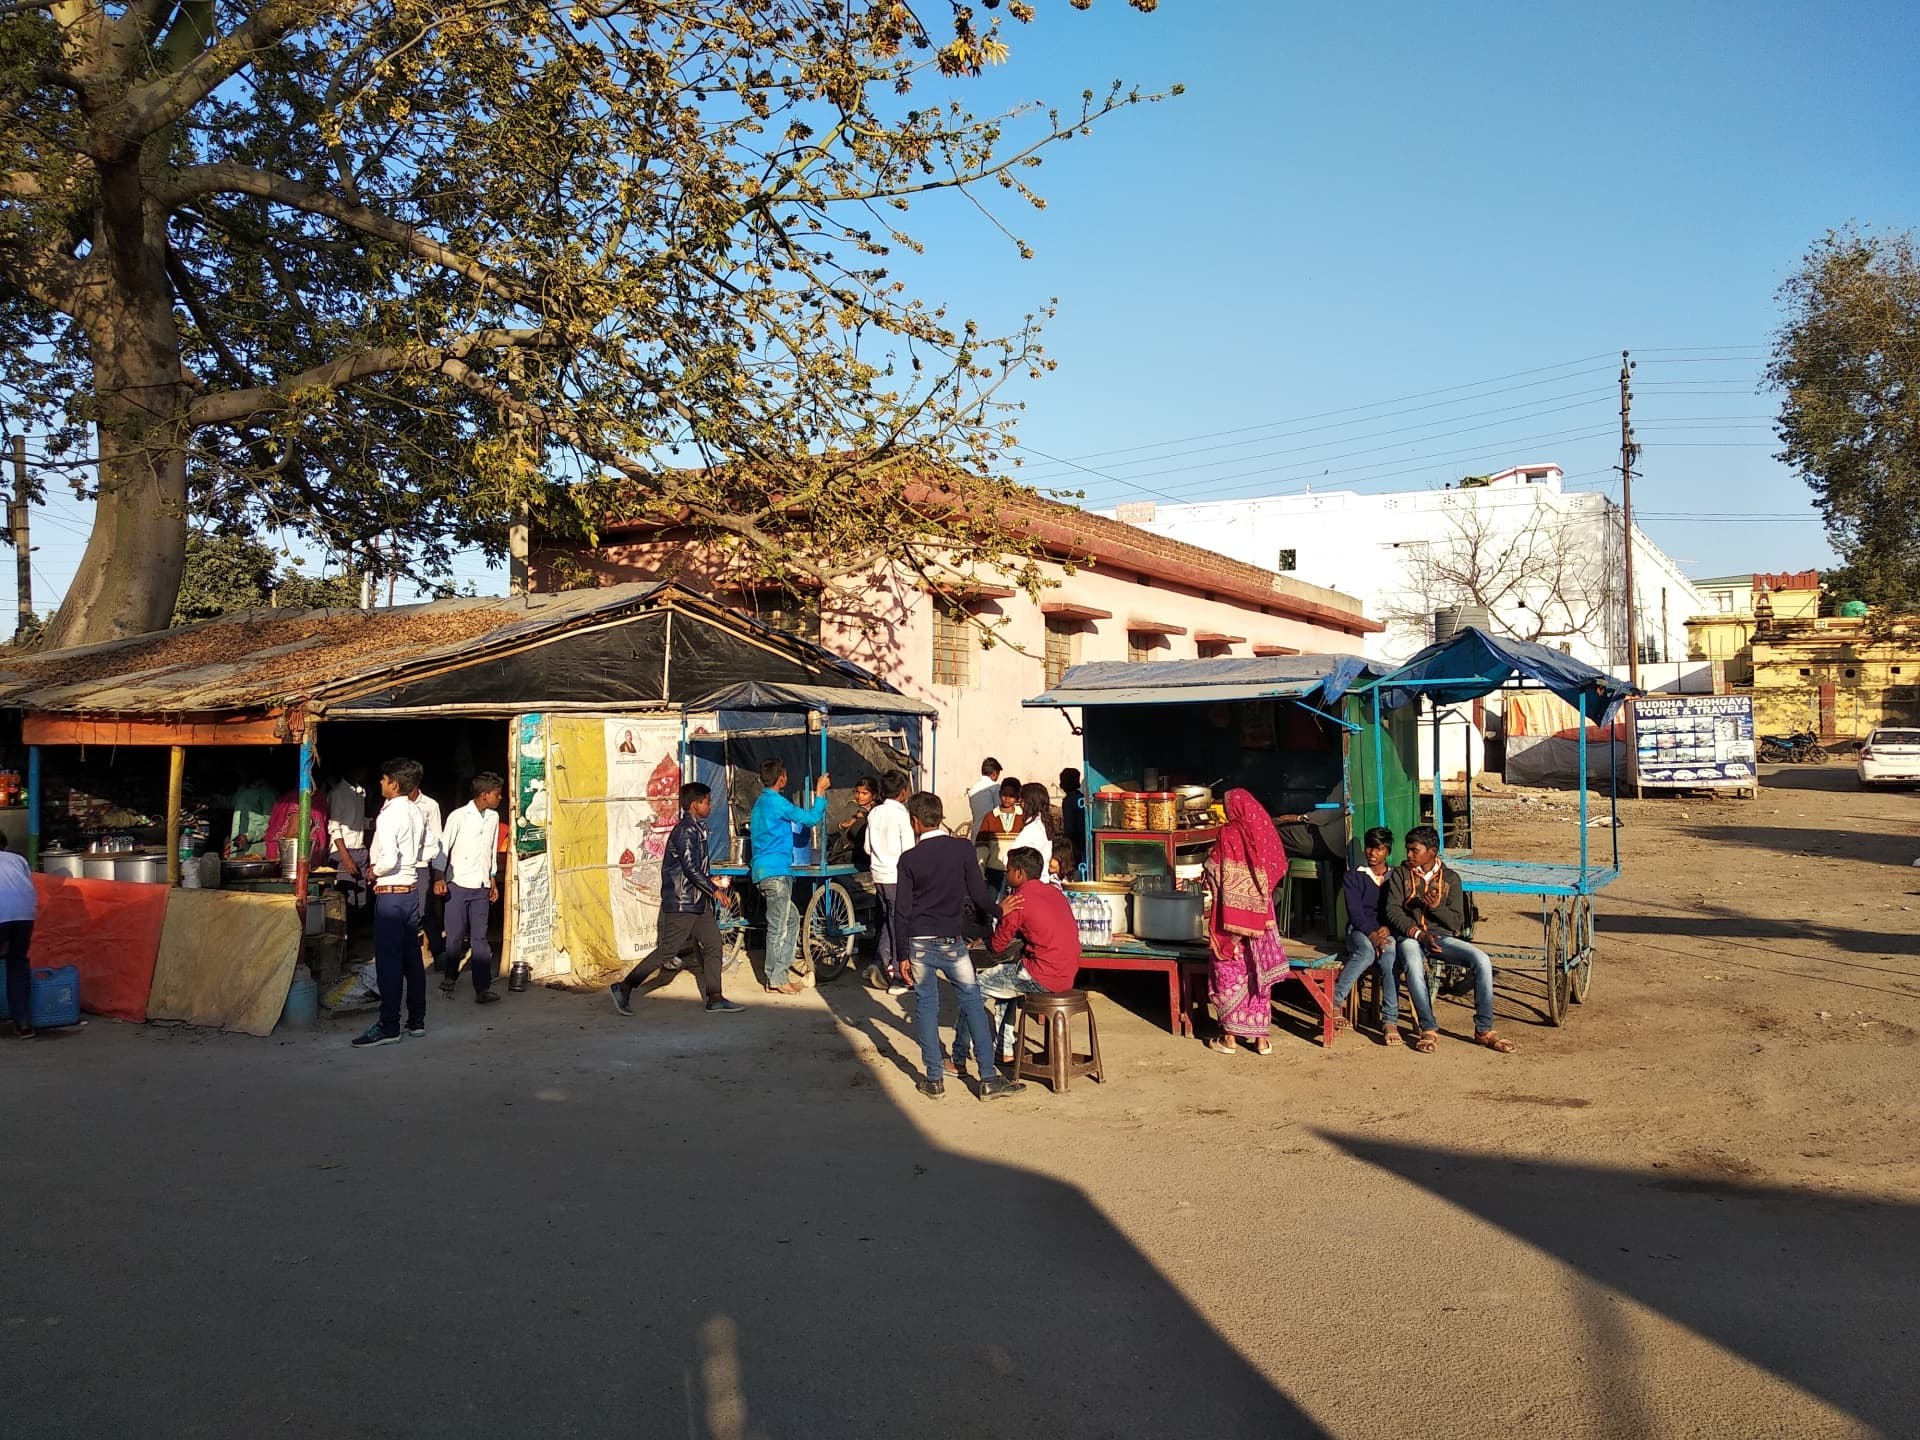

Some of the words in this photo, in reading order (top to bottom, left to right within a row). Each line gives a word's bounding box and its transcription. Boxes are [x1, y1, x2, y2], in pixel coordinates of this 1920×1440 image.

[1635, 700, 1684, 709] BUDDHA
[1687, 697, 1750, 707] BODHGAYA
[1638, 708, 1679, 716] TOURS
[1682, 707, 1691, 715] &
[1694, 705, 1750, 715] TRAVELS
